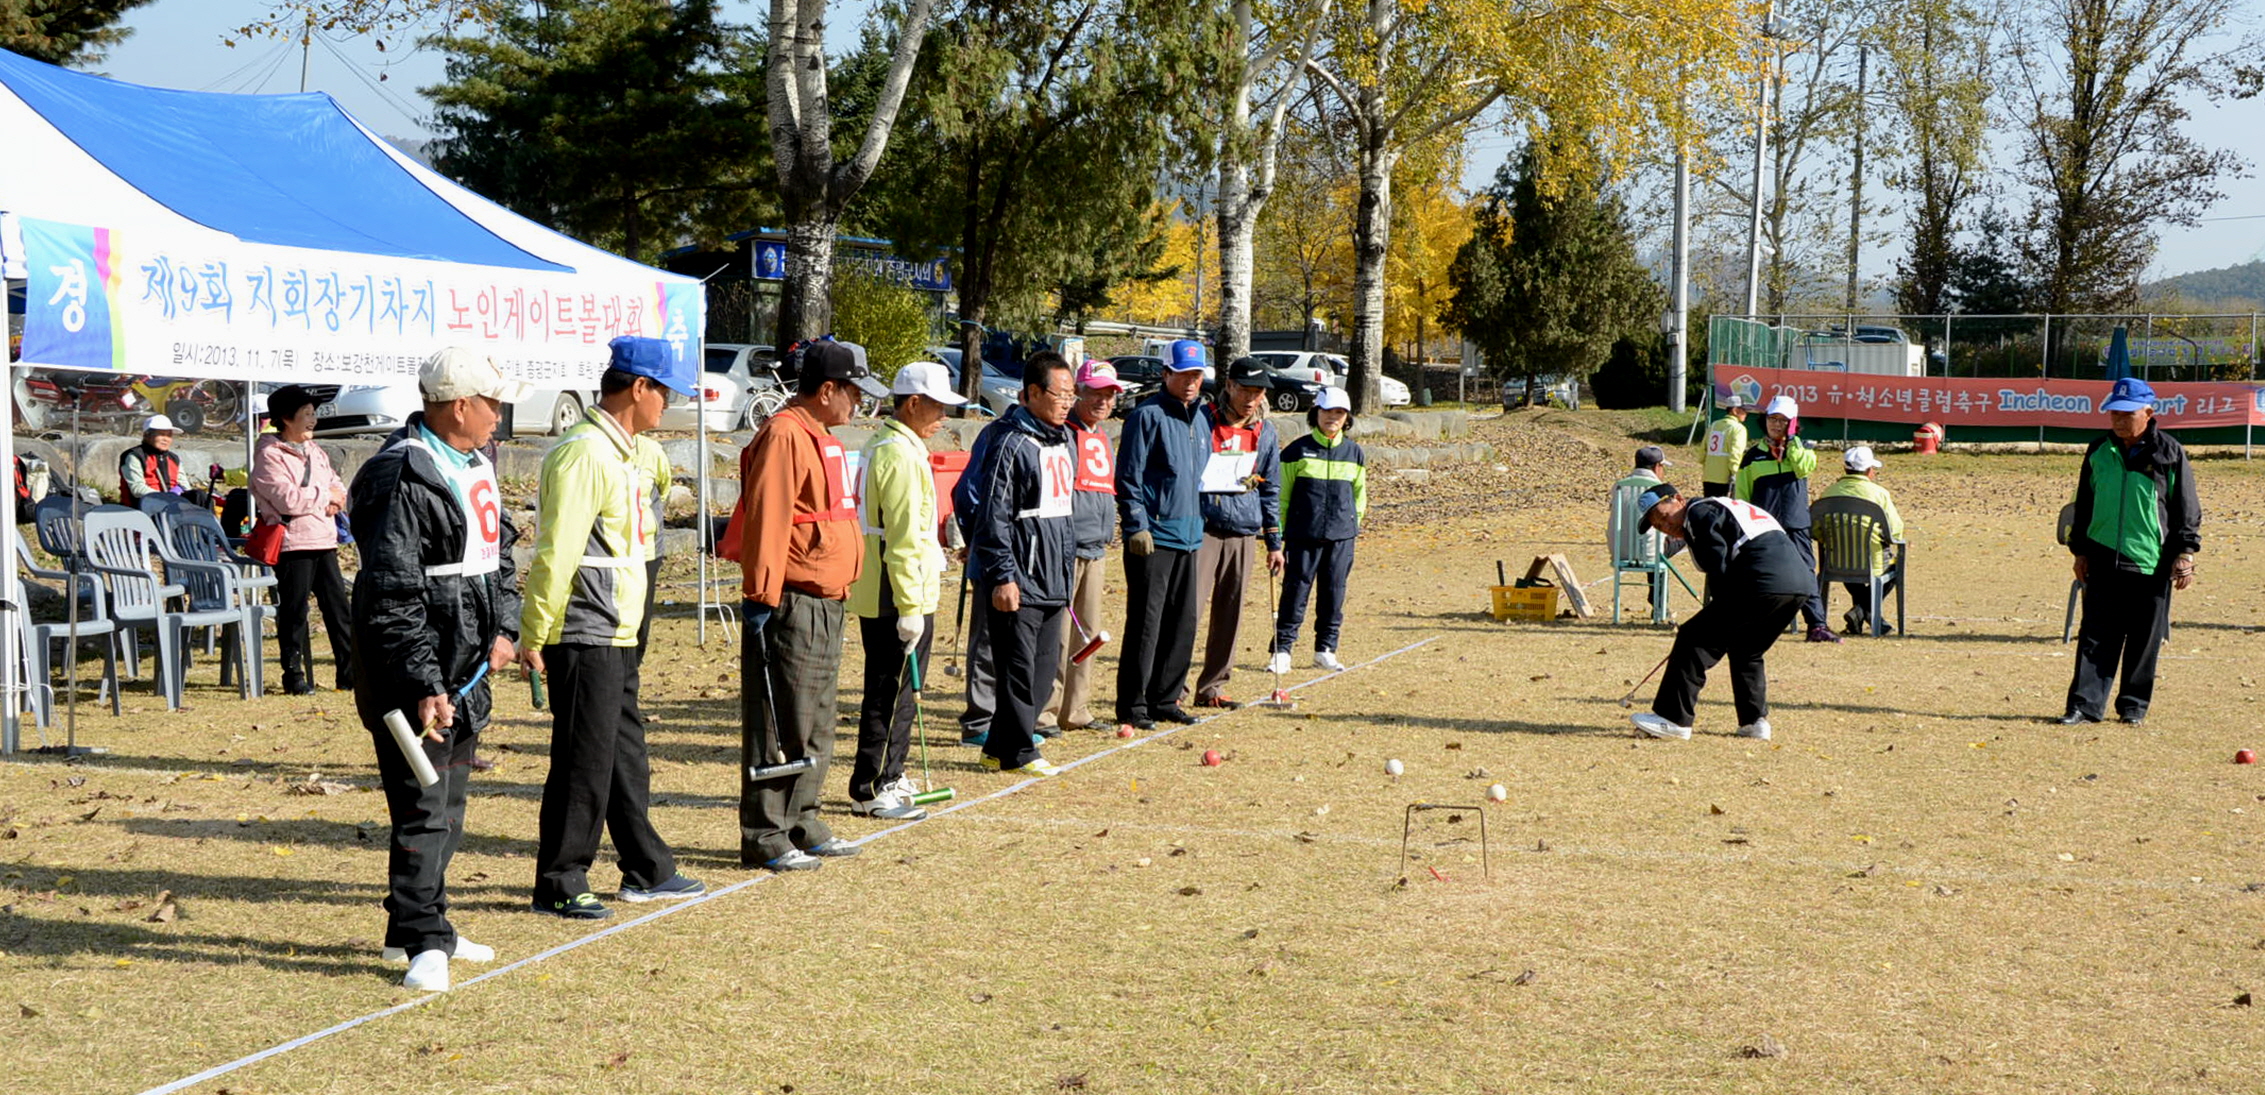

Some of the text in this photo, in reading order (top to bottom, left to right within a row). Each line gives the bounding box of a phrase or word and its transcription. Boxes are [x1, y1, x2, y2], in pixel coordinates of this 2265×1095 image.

[48, 258, 88, 333] 경
[140, 255, 644, 344] 제9회 지회장기차지 노인게이트볼대회
[1998, 388, 2092, 414] Incheon
[1084, 437, 1111, 478] 3
[1709, 434, 1720, 452] 3
[1045, 454, 1072, 498] 10
[469, 479, 500, 544] 6
